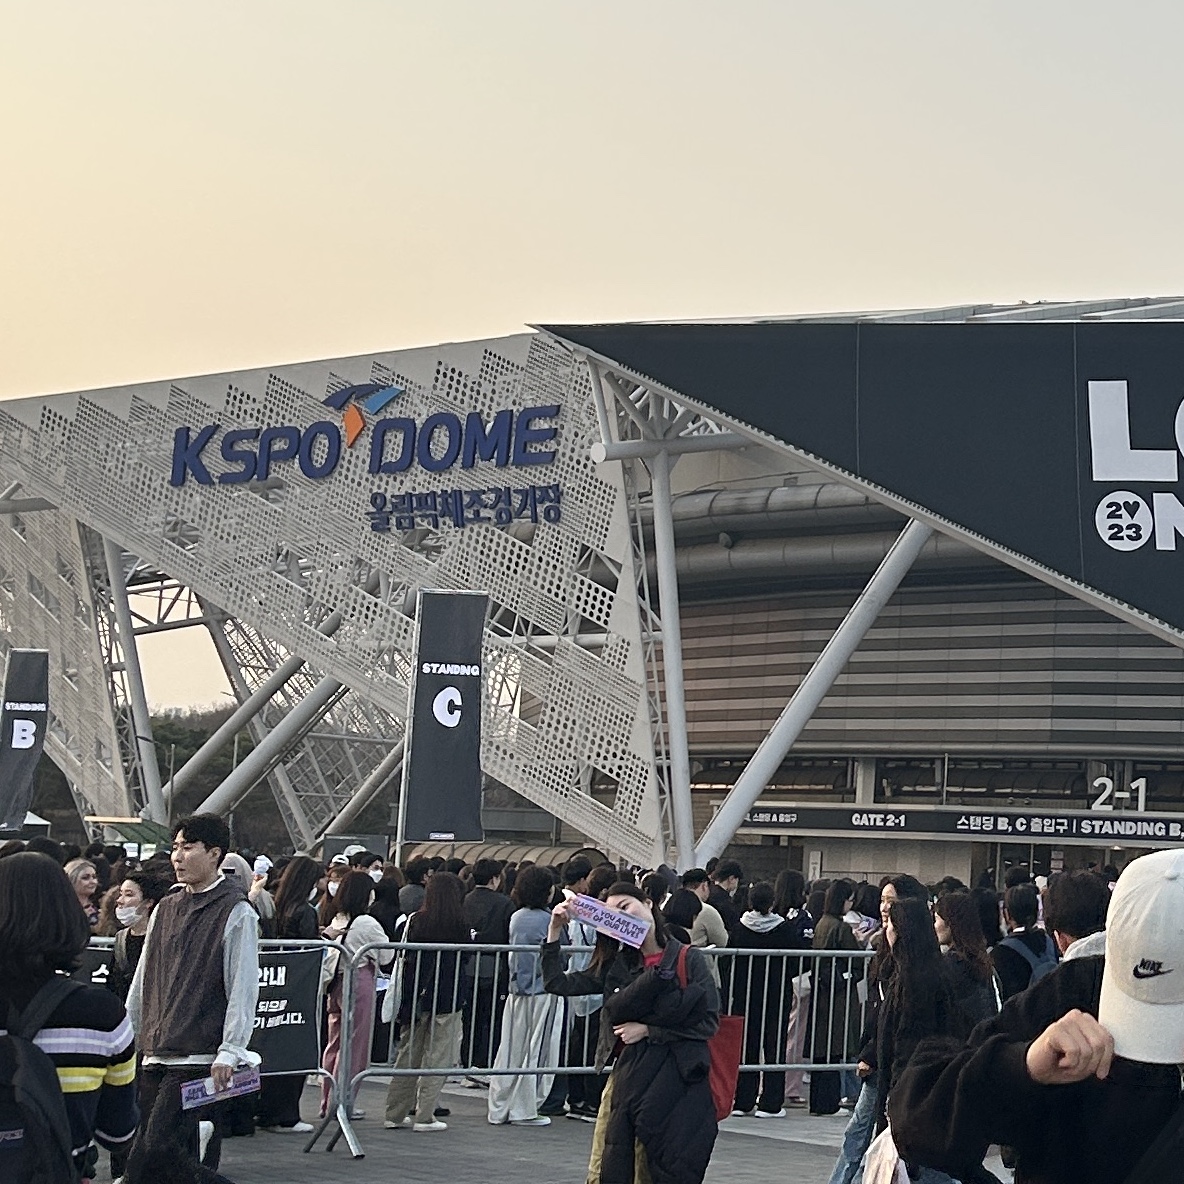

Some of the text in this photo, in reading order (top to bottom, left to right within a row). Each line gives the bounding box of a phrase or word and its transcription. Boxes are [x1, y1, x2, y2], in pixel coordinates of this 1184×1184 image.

[170, 404, 562, 487] KSPO DOME
[365, 484, 562, 532] 올림픽체조경기장
[1107, 523, 1143, 542] 23
[422, 662, 480, 676] STANDING
[432, 686, 463, 728] C
[11, 719, 37, 749] B
[1091, 777, 1148, 812] 2-1
[851, 813, 906, 827] GATE 2-1
[956, 815, 994, 831] 스탠딩
[1015, 817, 1027, 832] C
[1030, 817, 1069, 834] 출입구
[1080, 820, 1166, 836] STANDING
[600, 910, 616, 921] YOU
[631, 924, 646, 935] THE
